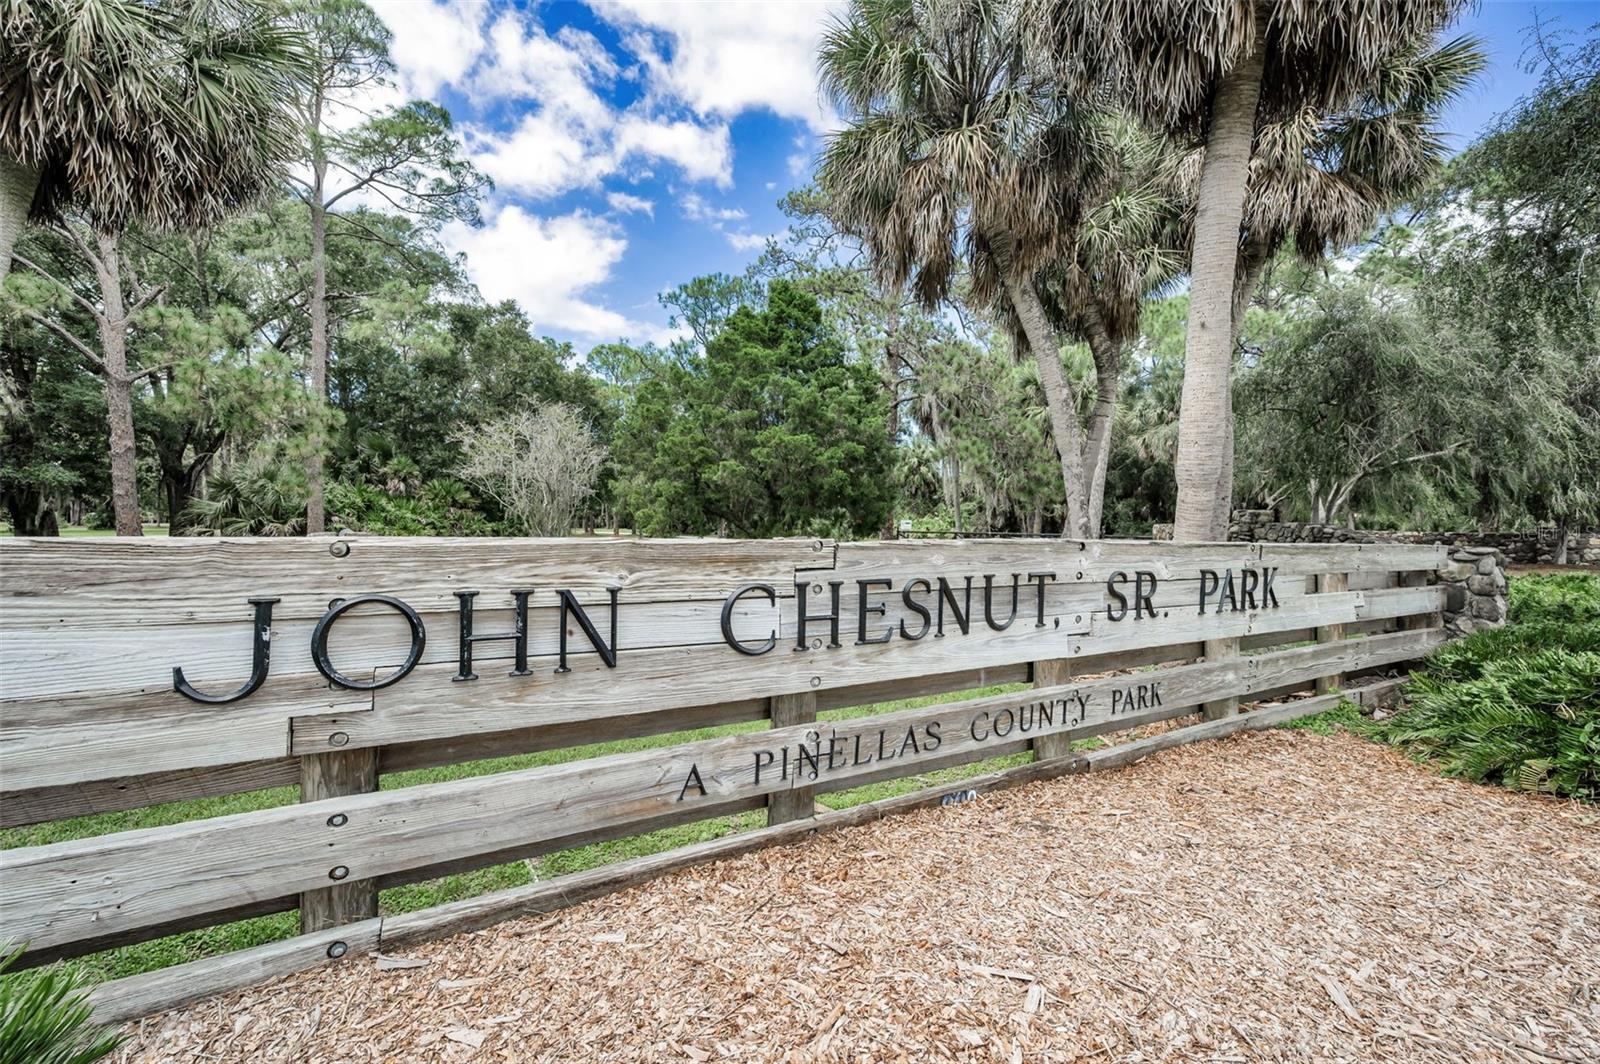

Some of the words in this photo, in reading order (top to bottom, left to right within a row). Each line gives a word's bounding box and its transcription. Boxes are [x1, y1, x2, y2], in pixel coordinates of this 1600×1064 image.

[172, 586, 623, 704] JOHN
[720, 570, 1060, 656] CHESNUT,
[1106, 570, 1169, 622] SR.
[1198, 566, 1281, 616] PARK
[677, 763, 708, 801] A
[753, 720, 942, 786] PINELLAS
[970, 692, 1092, 743] COUNTY
[1111, 682, 1164, 715] PARK
